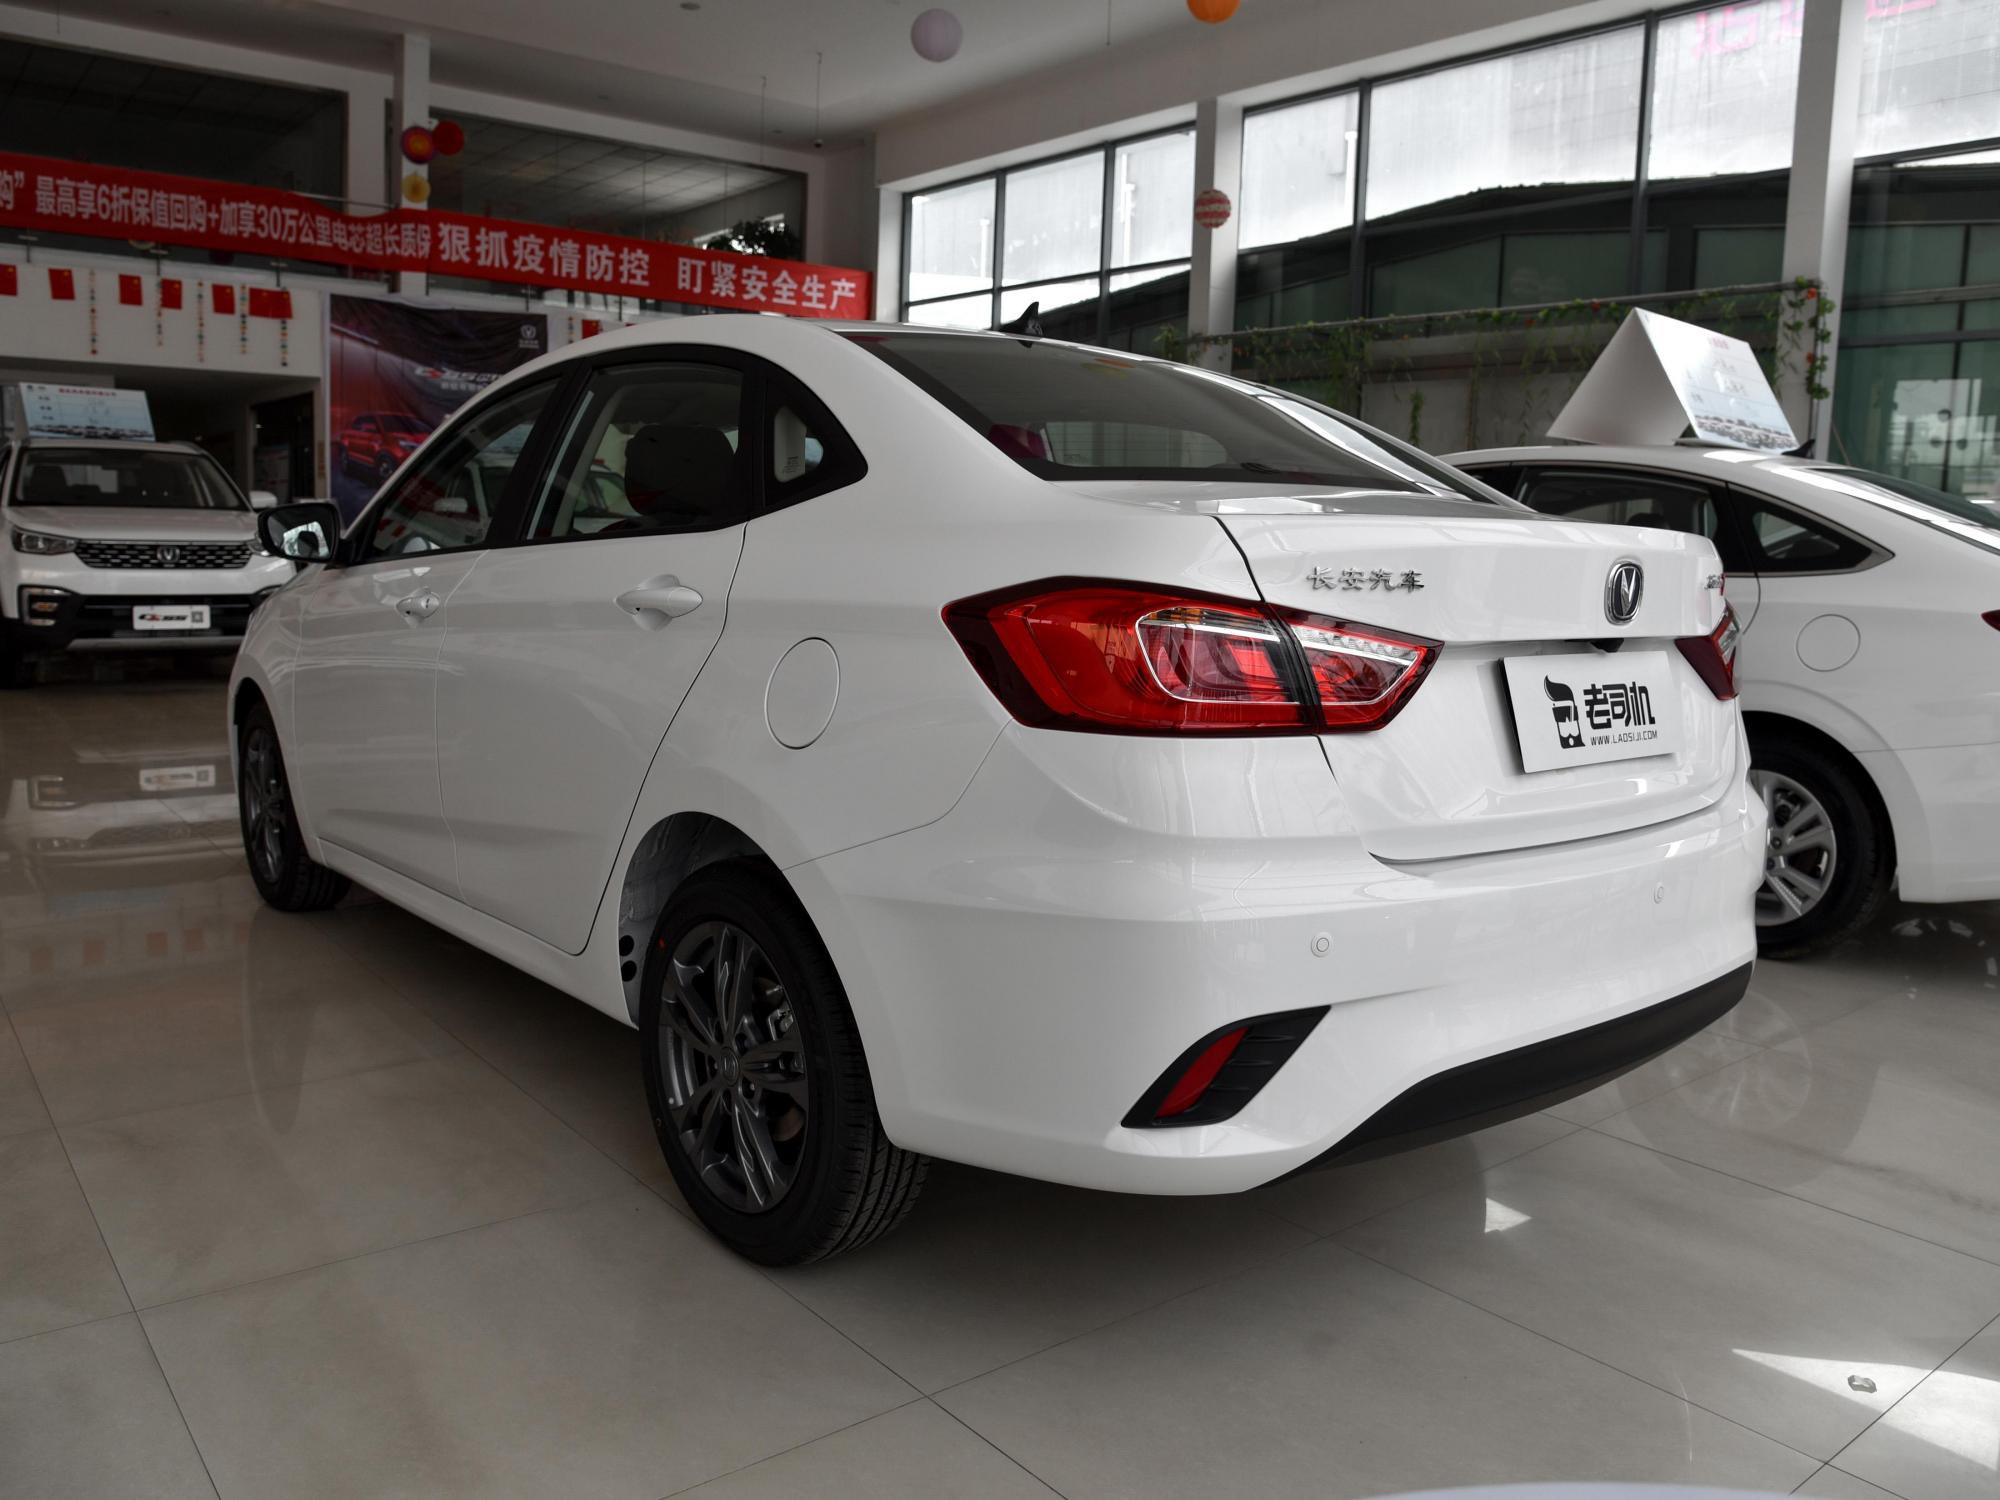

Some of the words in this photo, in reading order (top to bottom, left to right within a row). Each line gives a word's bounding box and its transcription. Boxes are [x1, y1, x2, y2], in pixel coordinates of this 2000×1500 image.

[35, 175, 431, 259] 最高享6折保值回购+加享30万公里电芯超长质保
[437, 221, 651, 287] 狠抓疫情防控
[677, 256, 856, 311] 盯紧安全生产
[1306, 566, 1425, 593] 长安汽车
[1583, 681, 1656, 730] 老司机
[1590, 730, 1658, 746] WWW.LAOSIJI.COM
